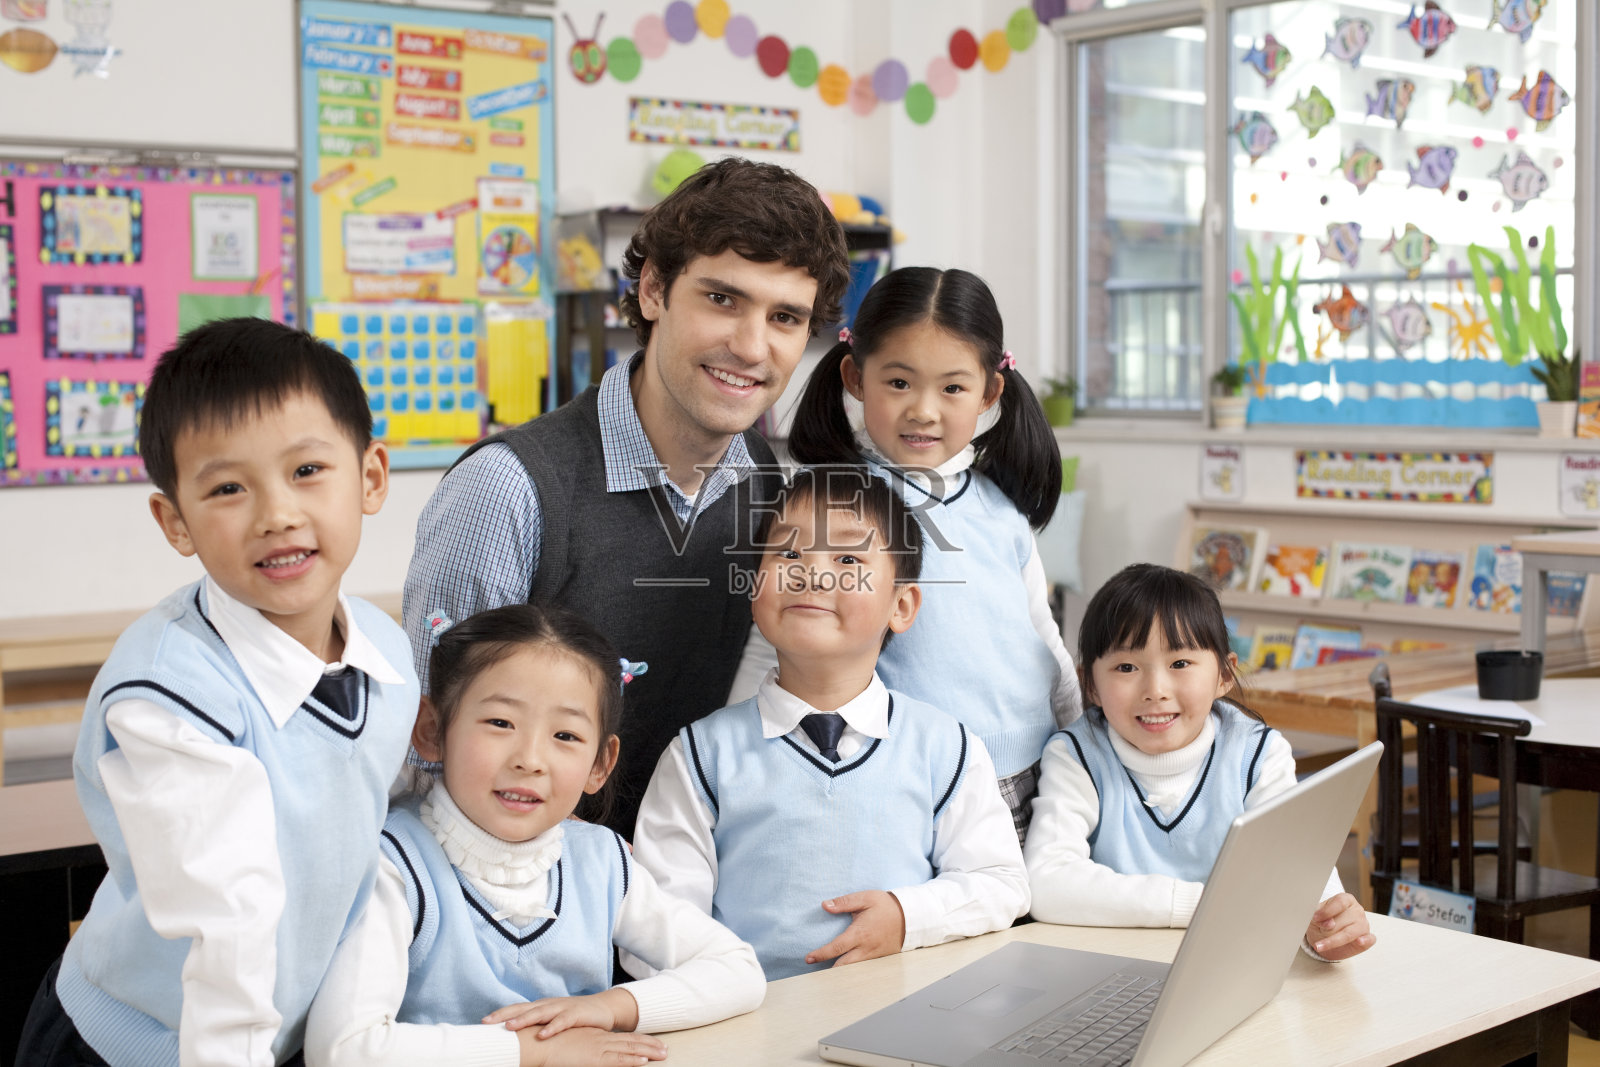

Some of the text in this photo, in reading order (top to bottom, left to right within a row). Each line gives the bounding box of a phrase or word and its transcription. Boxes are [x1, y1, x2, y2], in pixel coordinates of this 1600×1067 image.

[306, 22, 365, 43] January
[401, 33, 432, 53] June
[465, 29, 522, 53] October
[305, 44, 372, 73] February
[319, 76, 365, 95] March
[401, 66, 430, 88] July
[322, 105, 356, 126] April
[397, 94, 447, 117] August
[640, 106, 784, 139] Reading Corner
[321, 134, 353, 156] May
[388, 122, 461, 147] September
[1307, 458, 1475, 487] Reading Corner
[1427, 903, 1467, 925] Stefan
